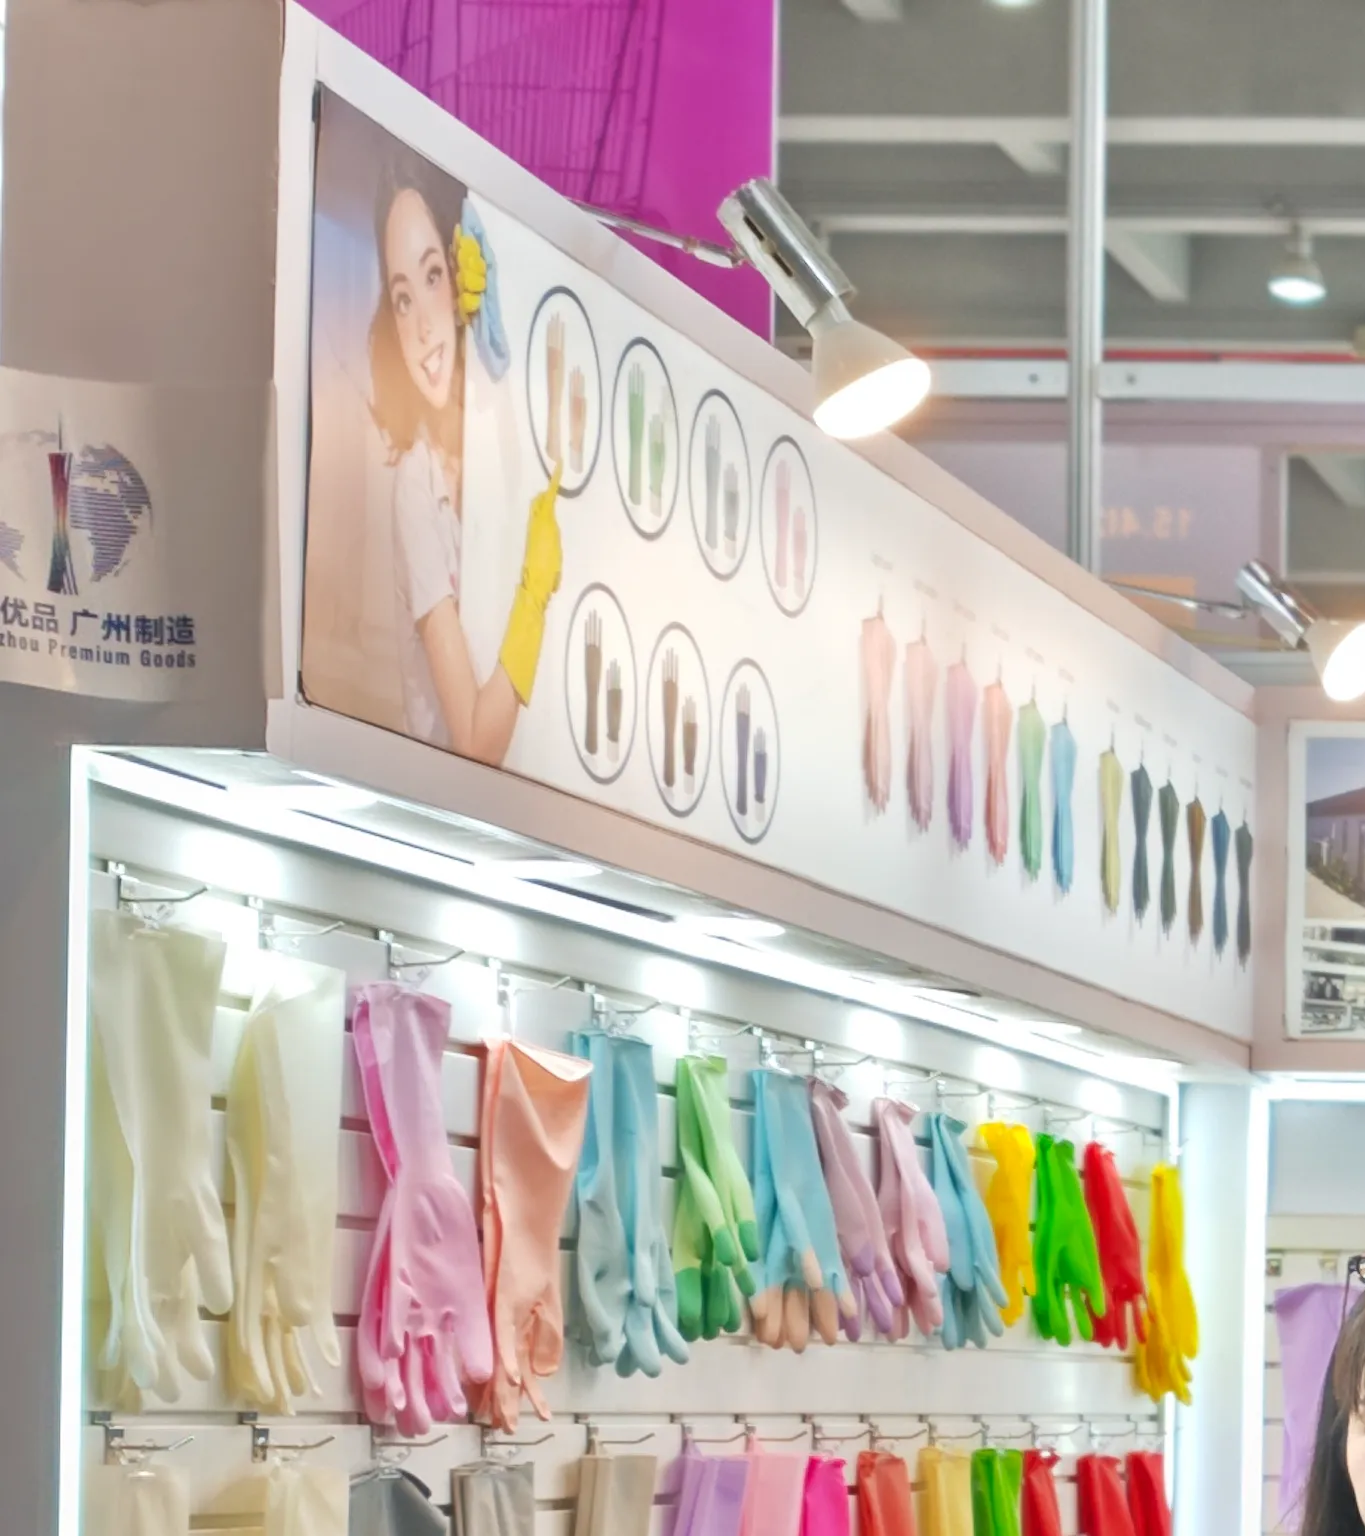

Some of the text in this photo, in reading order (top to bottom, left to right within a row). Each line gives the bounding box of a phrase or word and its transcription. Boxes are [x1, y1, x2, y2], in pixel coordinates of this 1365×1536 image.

[0, 596, 196, 646] 优品 广州制造
[48, 638, 130, 666] Premium
[140, 649, 197, 668] Goods
